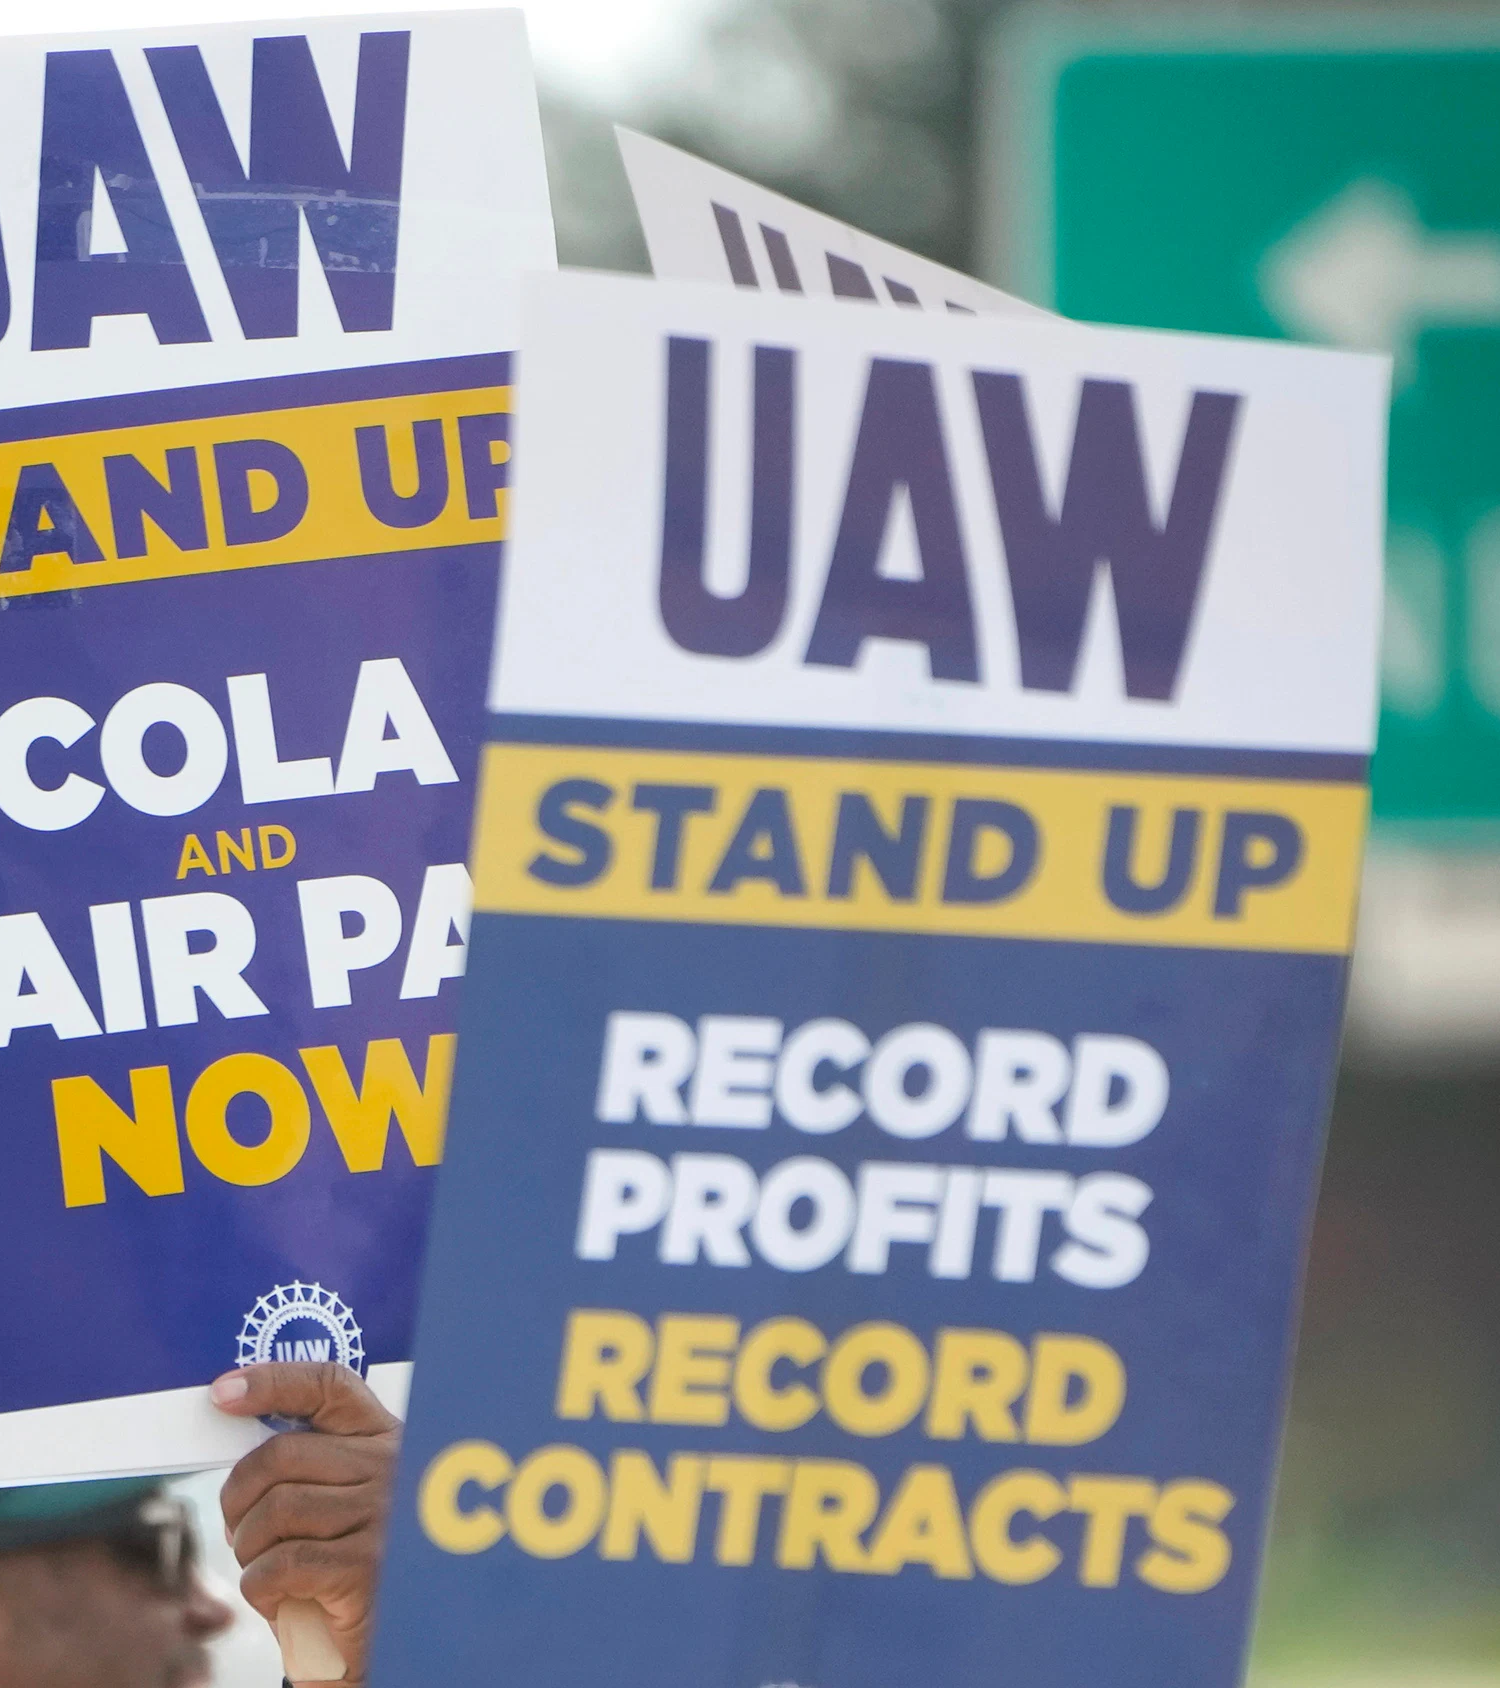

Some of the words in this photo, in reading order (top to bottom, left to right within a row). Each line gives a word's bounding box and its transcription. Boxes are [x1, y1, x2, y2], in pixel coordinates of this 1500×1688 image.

[354, 411, 514, 530] UP
[657, 334, 1246, 706] UAW
[176, 824, 297, 881] AND
[525, 777, 1043, 909] STAND
[1099, 804, 1306, 920] UP
[51, 1032, 458, 1209] NOW
[596, 1010, 1170, 1149] RECORD
[574, 1149, 1153, 1290] PROFITS
[557, 1308, 1128, 1448] RECORD
[417, 1440, 1236, 1595] CONTRACTS
